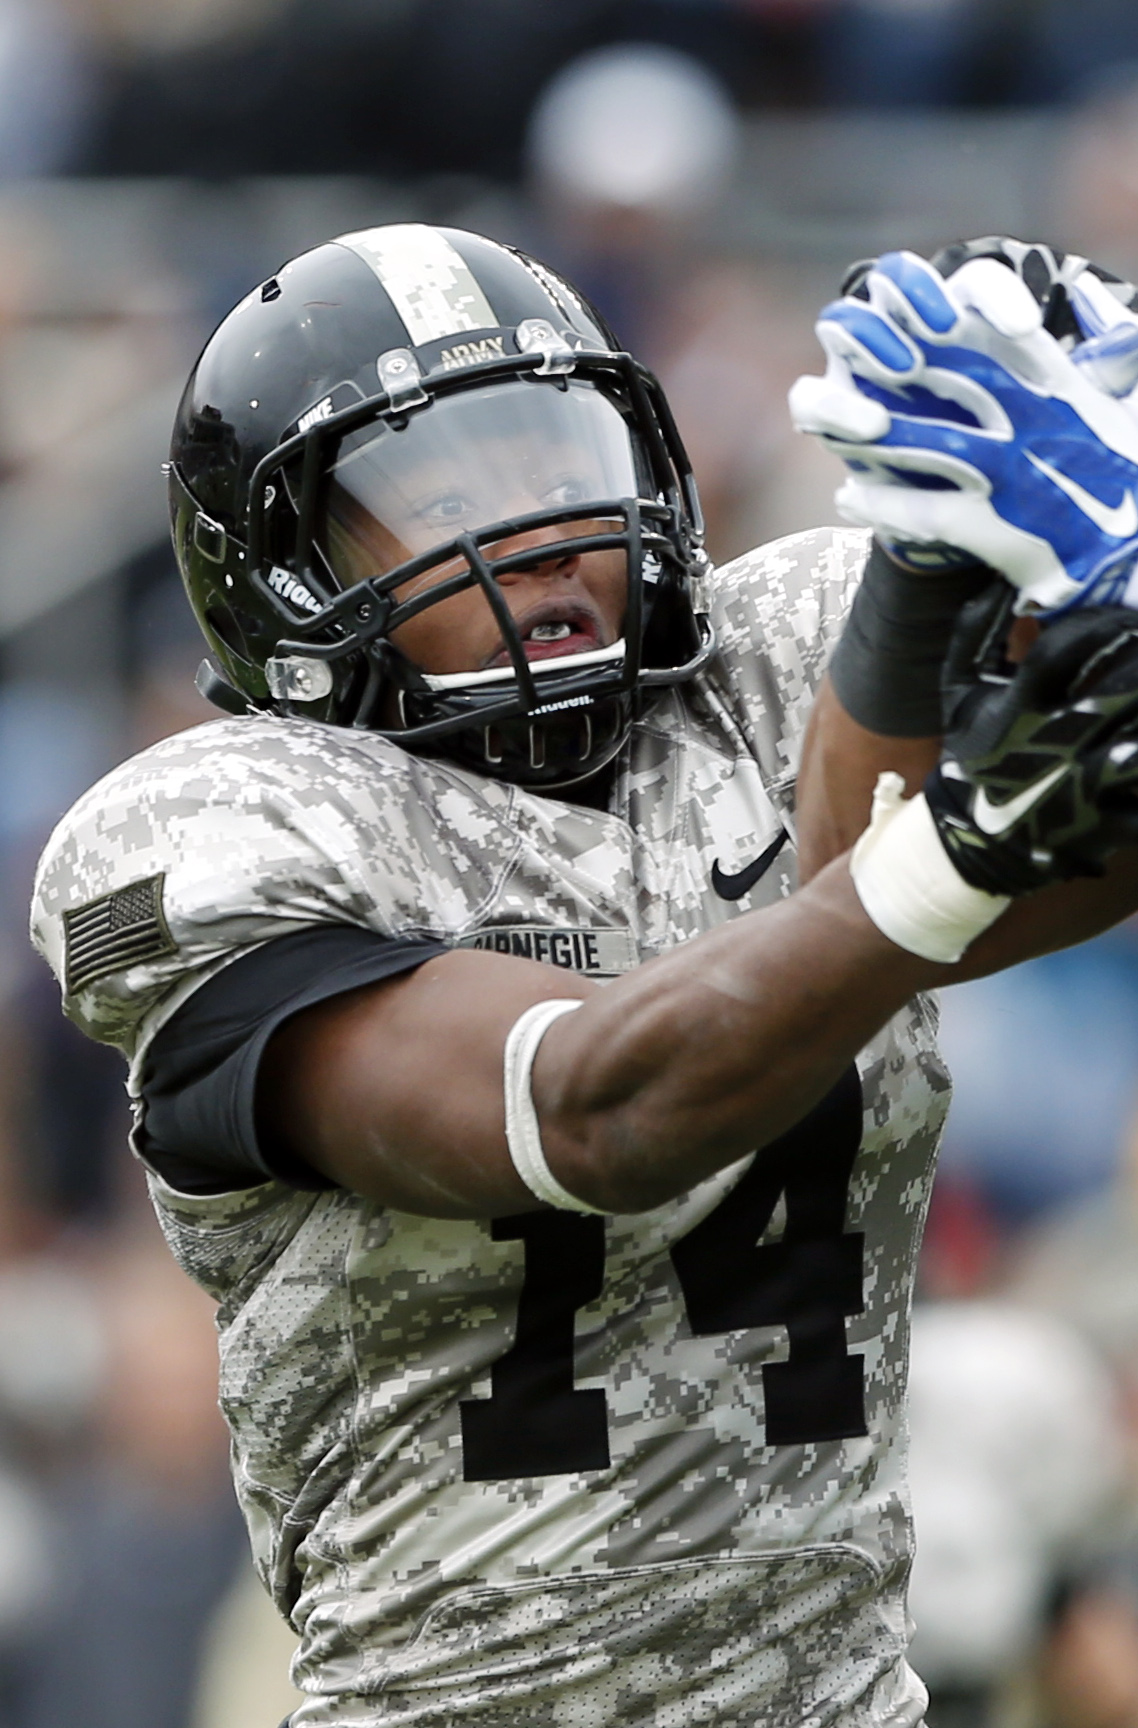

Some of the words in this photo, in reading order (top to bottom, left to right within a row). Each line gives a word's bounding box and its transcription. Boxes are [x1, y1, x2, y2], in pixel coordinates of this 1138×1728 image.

[441, 336, 507, 371] ARMY
[297, 396, 335, 433] NIKE
[459, 1060, 869, 1482] 14
